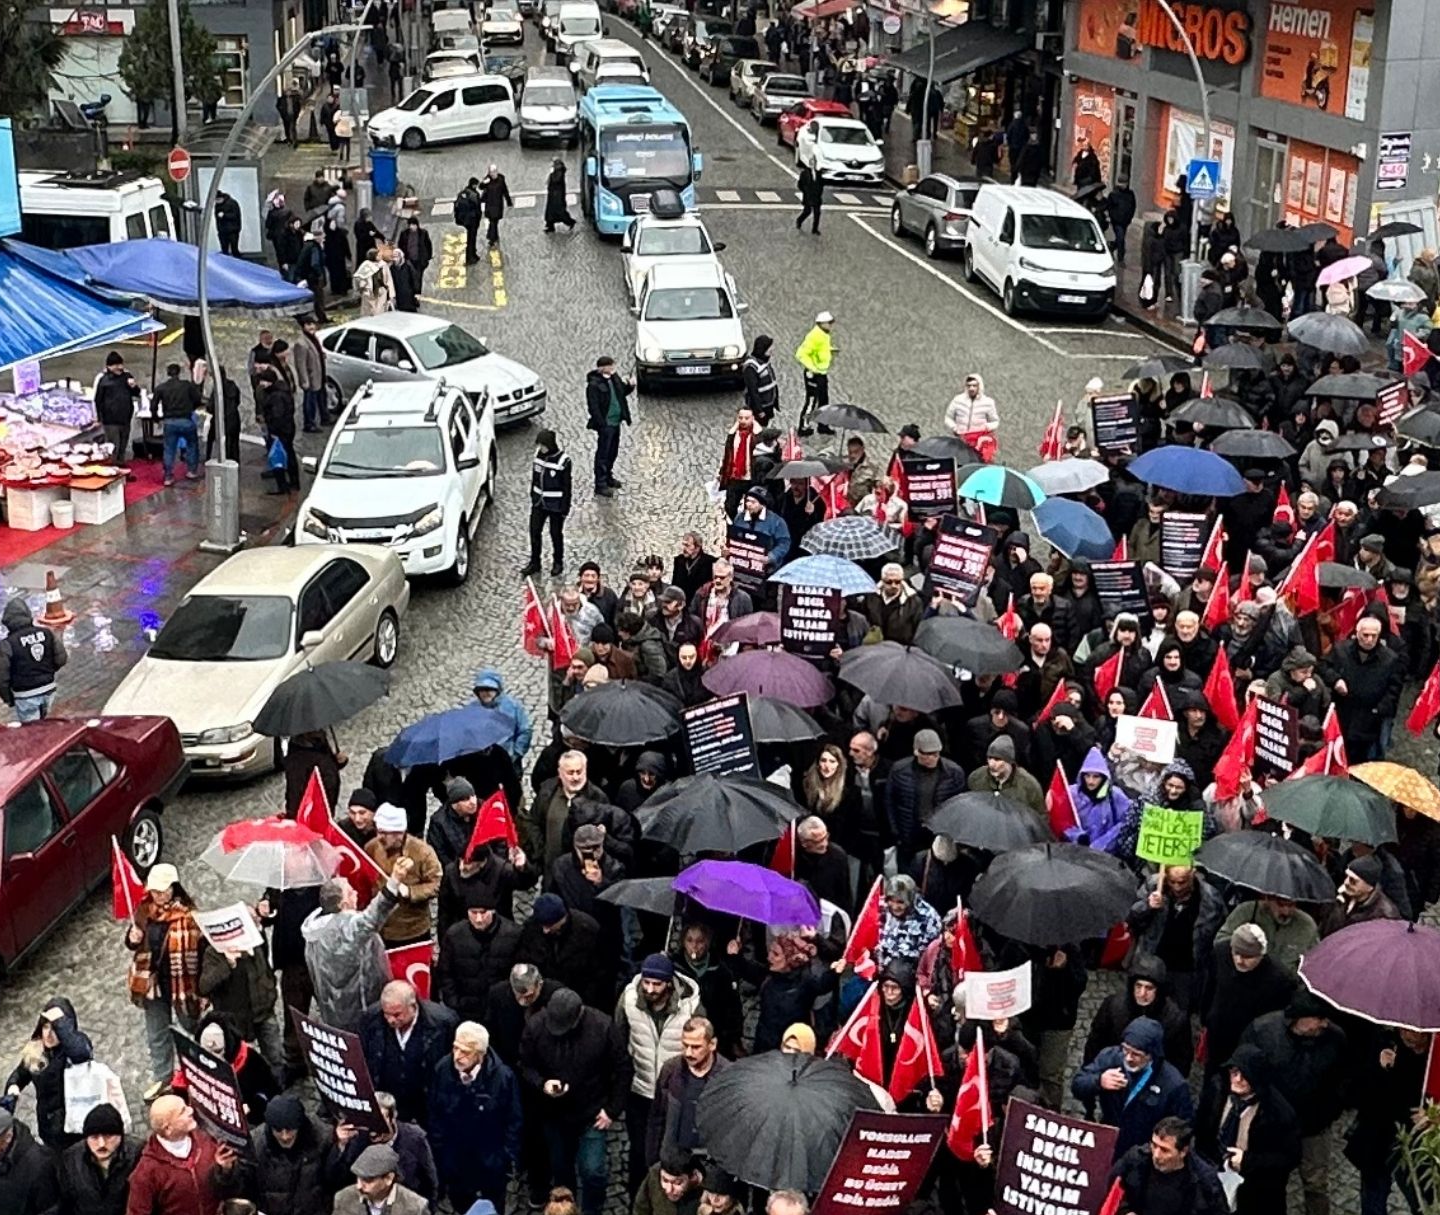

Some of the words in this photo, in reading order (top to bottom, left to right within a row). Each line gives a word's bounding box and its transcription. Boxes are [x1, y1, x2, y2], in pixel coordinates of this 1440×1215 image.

[1139, 0, 1250, 64] MIGROS
[1269, 4, 1332, 39] Hemen
[1024, 1113, 1095, 1148] SADAKA
[1032, 1136, 1080, 1164] DEĞİL
[1016, 1150, 1089, 1187] İNSANCA
[1020, 1173, 1081, 1205] YAŞAM
